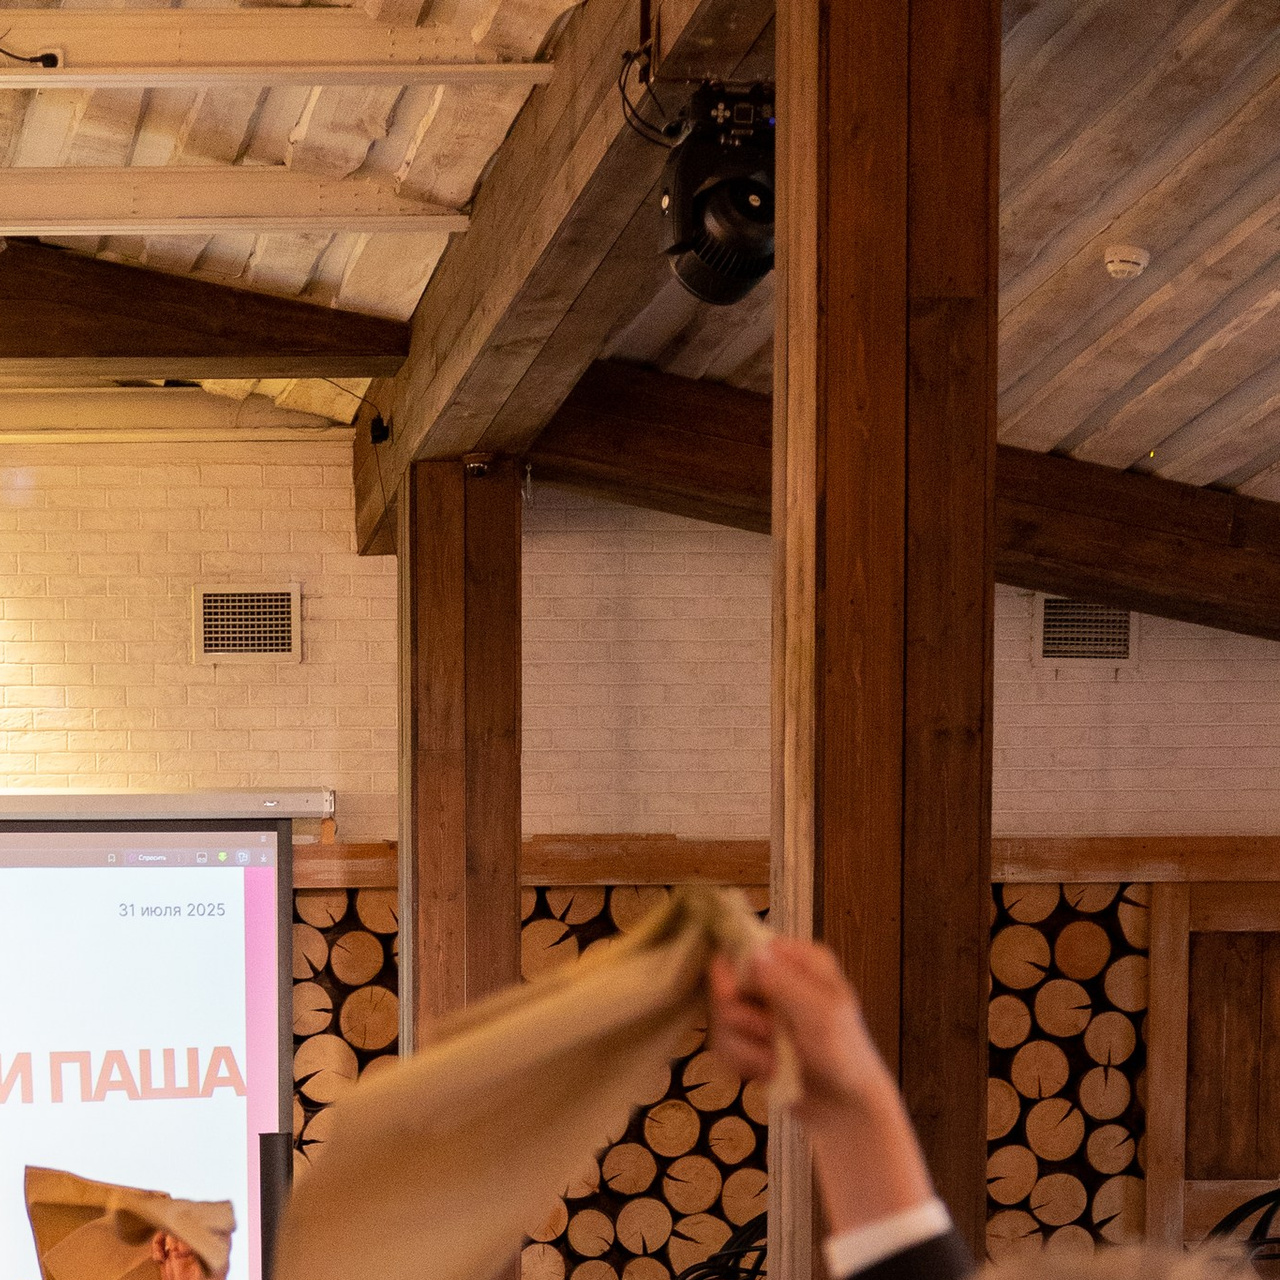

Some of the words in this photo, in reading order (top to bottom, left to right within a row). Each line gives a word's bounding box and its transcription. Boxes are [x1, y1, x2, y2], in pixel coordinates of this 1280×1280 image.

[118, 903, 134, 917] 31
[141, 906, 181, 917] июля
[187, 902, 225, 917] 2025
[49, 1046, 247, 1103] ПАША
